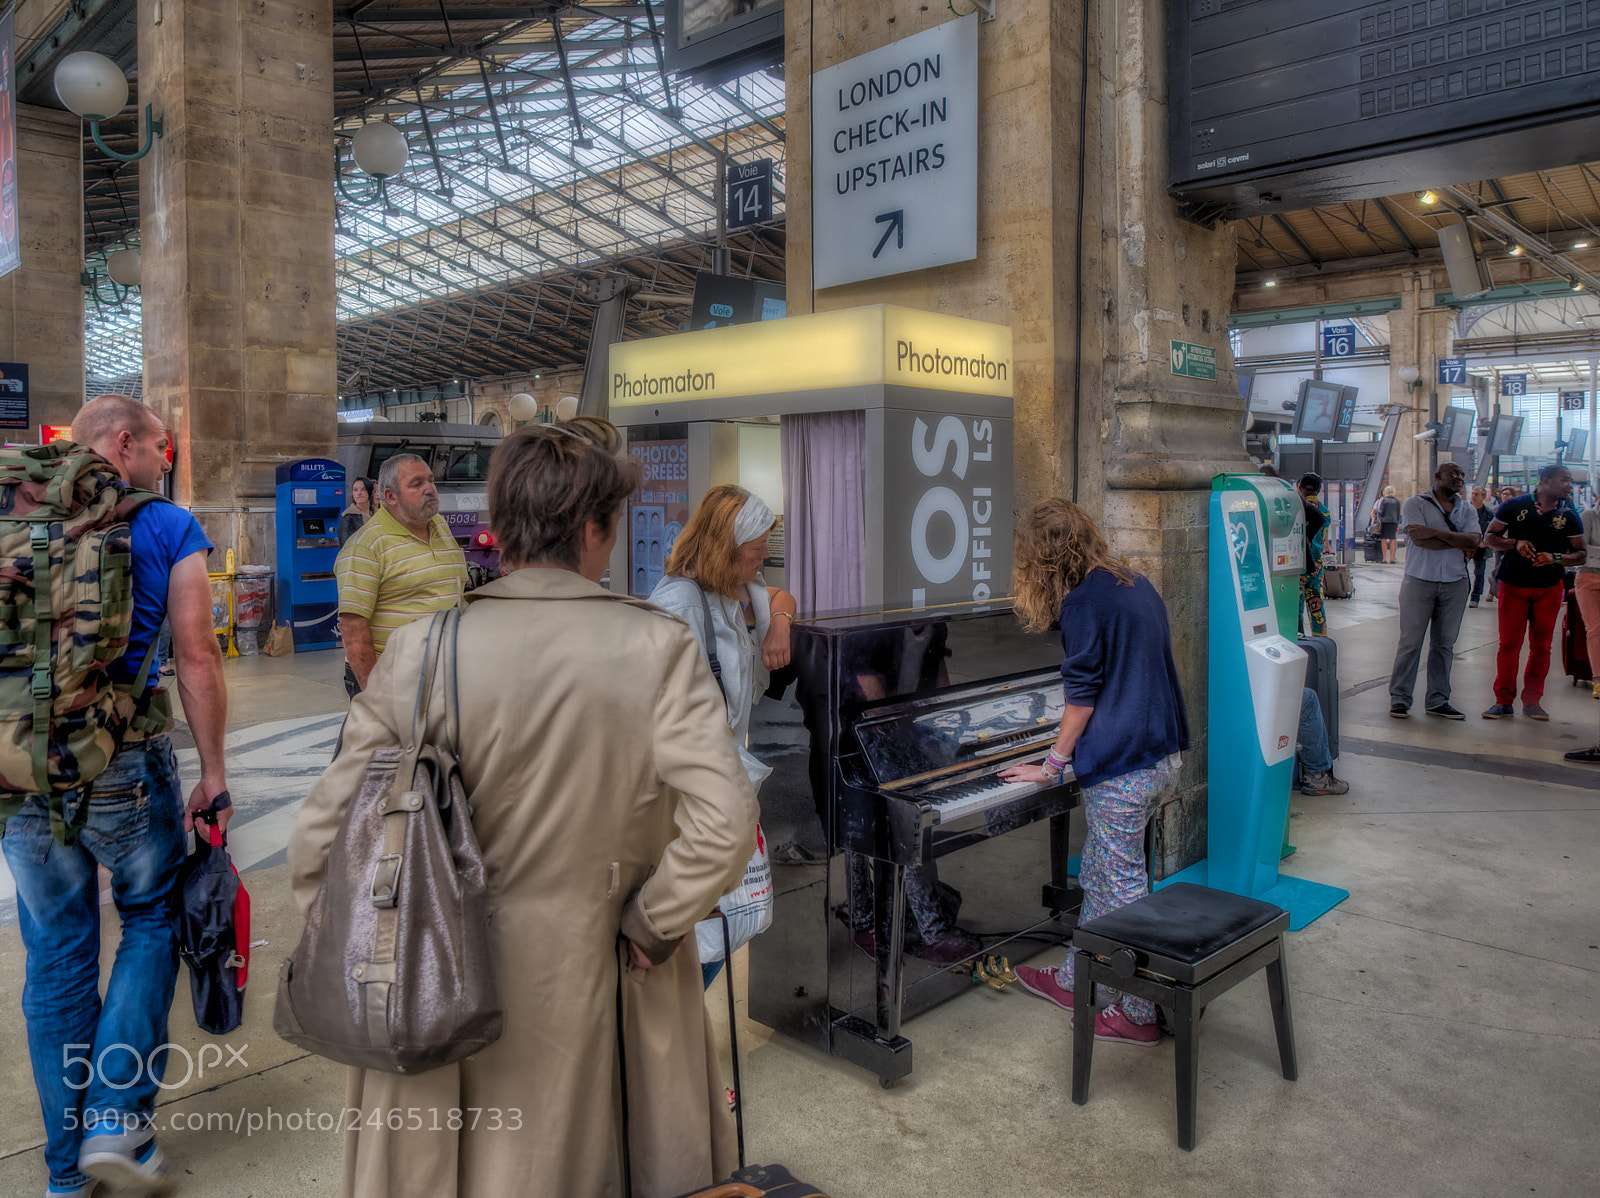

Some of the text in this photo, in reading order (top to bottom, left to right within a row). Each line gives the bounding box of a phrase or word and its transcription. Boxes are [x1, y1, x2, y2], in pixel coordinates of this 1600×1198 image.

[838, 53, 941, 112] LONDON
[833, 96, 947, 154] CHECK-IN
[738, 164, 758, 179] Voie
[836, 143, 945, 195] UPSTAIRS
[1196, 159, 1216, 170] solari
[734, 184, 763, 222] 14
[712, 304, 731, 317] Voie
[1328, 337, 1349, 356] 16
[897, 340, 1007, 381] Photomaton
[613, 368, 716, 399] Photomaton
[1442, 367, 1462, 383] 17
[1505, 382, 1522, 395] 18
[1566, 398, 1580, 410] 19
[1341, 407, 1352, 425] 16
[632, 444, 688, 463] PHOTOS
[642, 463, 688, 481] GREEES
[446, 513, 477, 525] 15034
[910, 415, 969, 606] OS
[1516, 509, 1529, 522] 8
